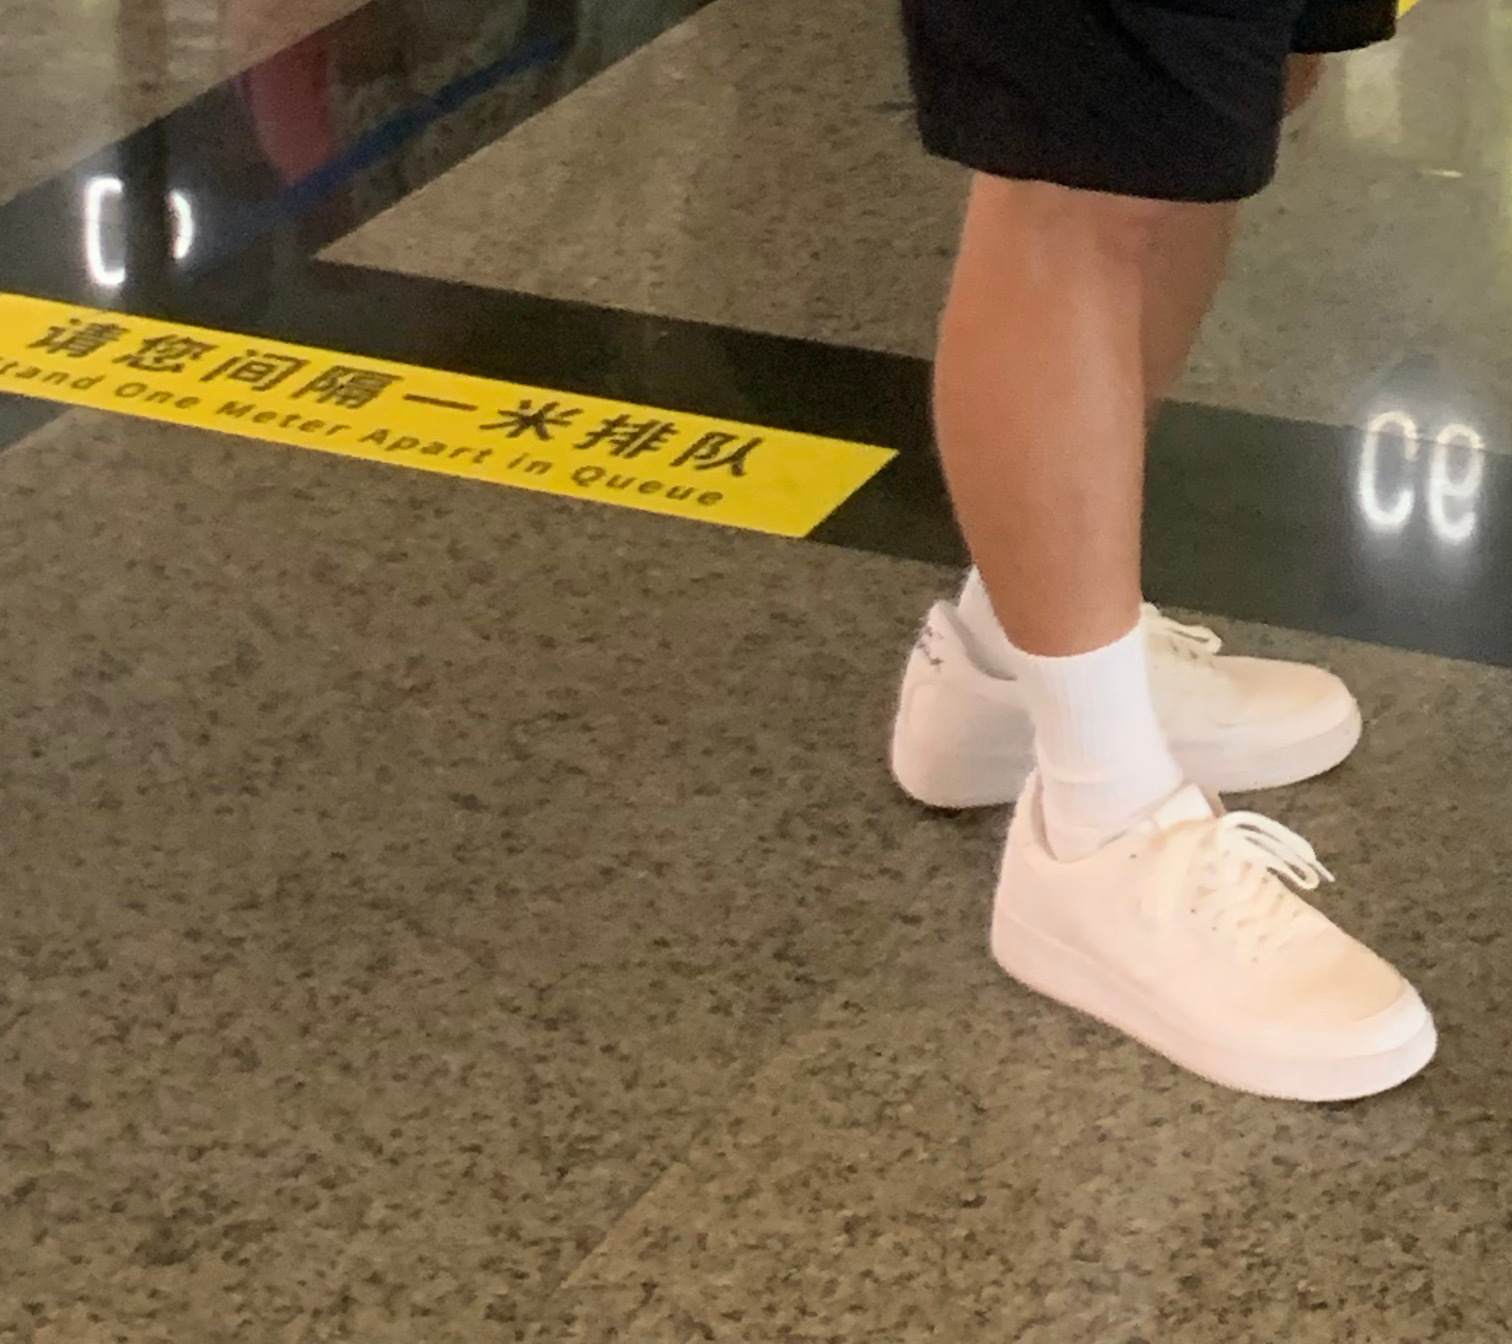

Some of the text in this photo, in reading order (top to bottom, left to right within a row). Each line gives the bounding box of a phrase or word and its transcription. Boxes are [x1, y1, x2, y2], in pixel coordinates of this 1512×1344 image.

[26, 318, 763, 477] 请您间隔一米排队
[115, 382, 201, 410] One
[216, 400, 352, 437] Meter
[358, 427, 493, 465] Apart
[507, 452, 554, 476] in
[570, 464, 724, 507] Queue
